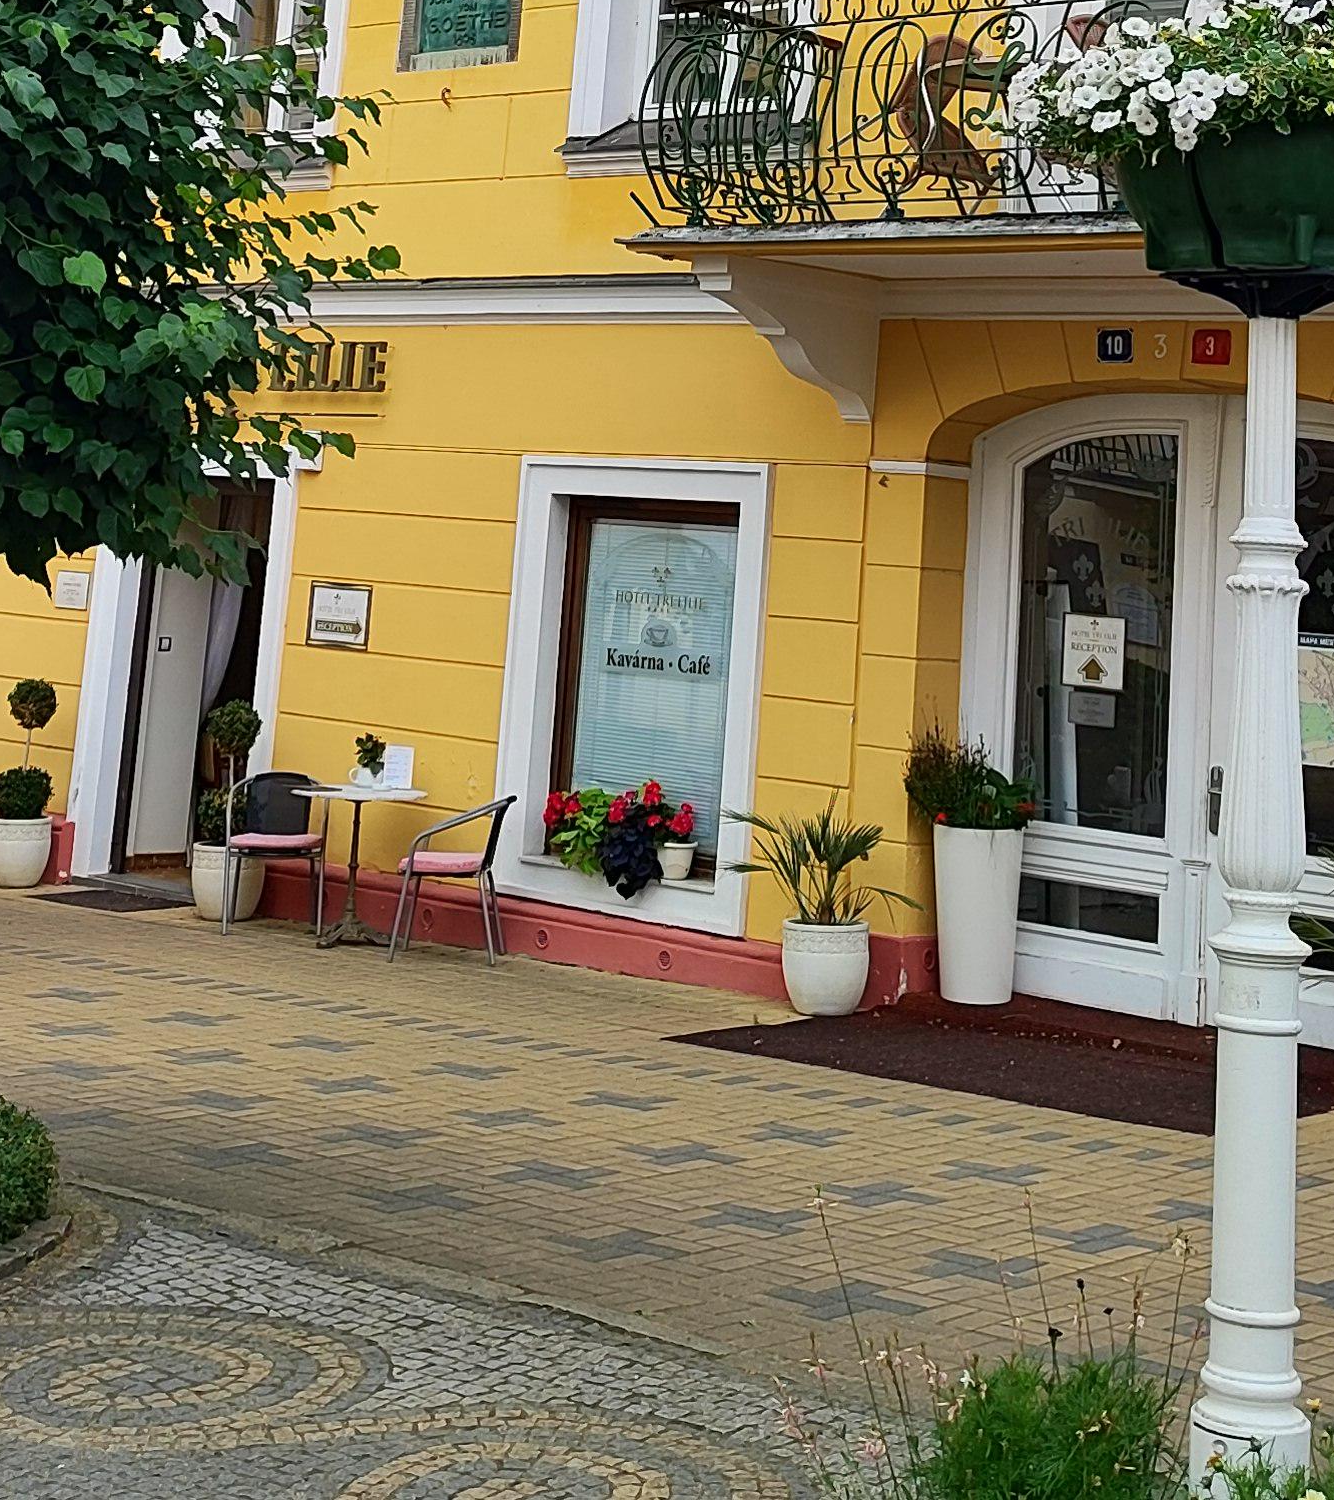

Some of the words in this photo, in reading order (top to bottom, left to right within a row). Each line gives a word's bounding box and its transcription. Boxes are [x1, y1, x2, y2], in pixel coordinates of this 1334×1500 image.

[428, 10, 508, 34] GOETHE
[1107, 335, 1123, 356] 10
[1153, 333, 1168, 359] 3
[1205, 335, 1215, 356] 3
[1071, 641, 1118, 654] RECEPTION
[607, 648, 665, 671] Kavárna
[677, 654, 712, 675] Café
